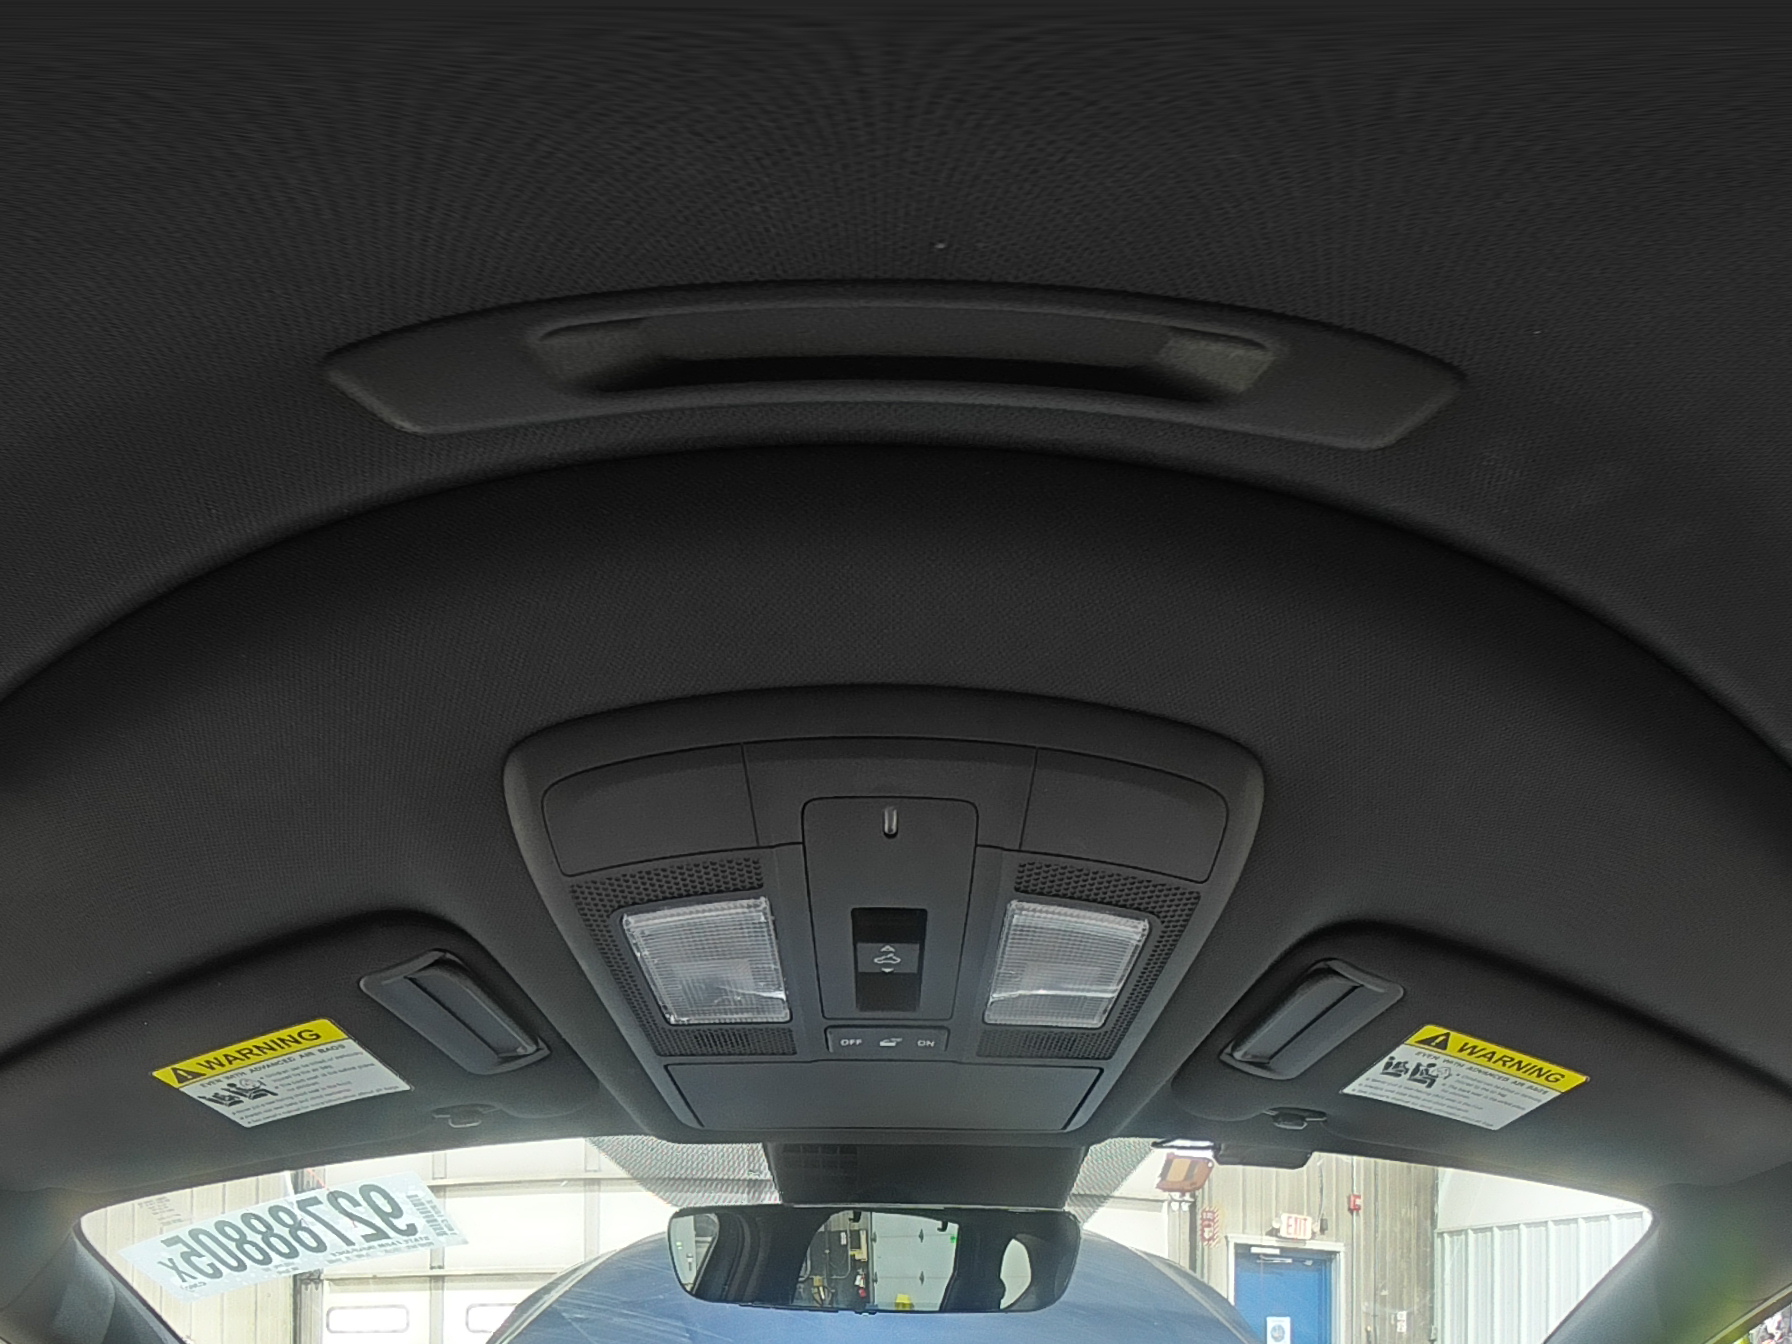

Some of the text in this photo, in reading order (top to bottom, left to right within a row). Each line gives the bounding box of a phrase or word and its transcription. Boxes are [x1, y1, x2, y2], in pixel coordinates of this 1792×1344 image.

[196, 1029, 321, 1071] WARNING
[840, 1038, 936, 1048] OFF ON
[249, 1056, 296, 1073] ADVANCED
[299, 1050, 316, 1059] AIR
[1457, 1042, 1566, 1083] WARNING
[1466, 1066, 1509, 1082] ADVANCED
[1287, 1216, 1308, 1237] EXIT
